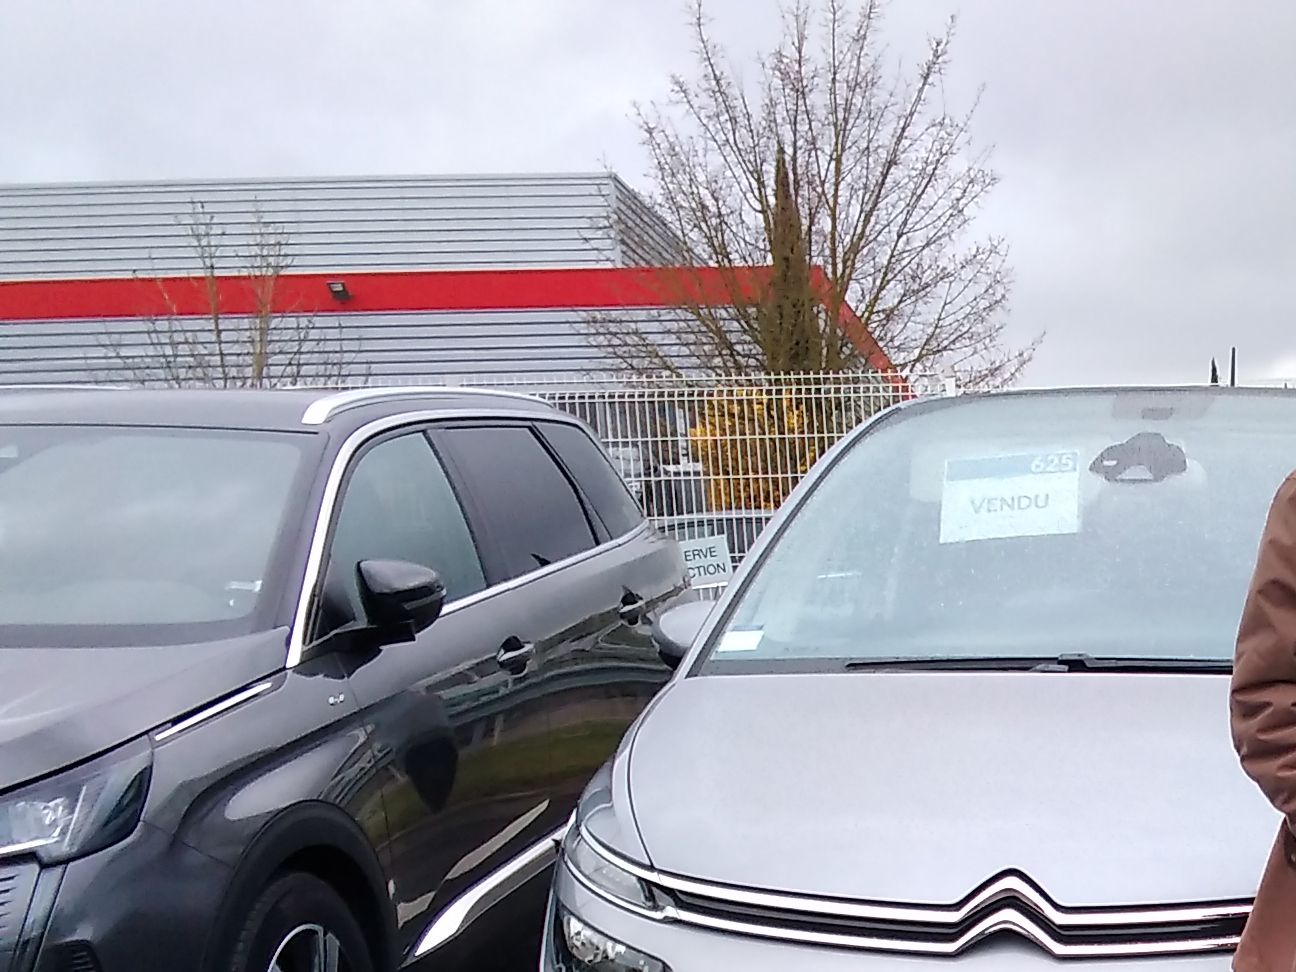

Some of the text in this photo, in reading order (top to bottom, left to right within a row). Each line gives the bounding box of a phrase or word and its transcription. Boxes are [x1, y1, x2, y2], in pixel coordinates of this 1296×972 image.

[1030, 454, 1074, 473] 625
[970, 493, 1051, 515] VENDU
[683, 546, 718, 562] ERVE
[687, 562, 727, 579] CTION
